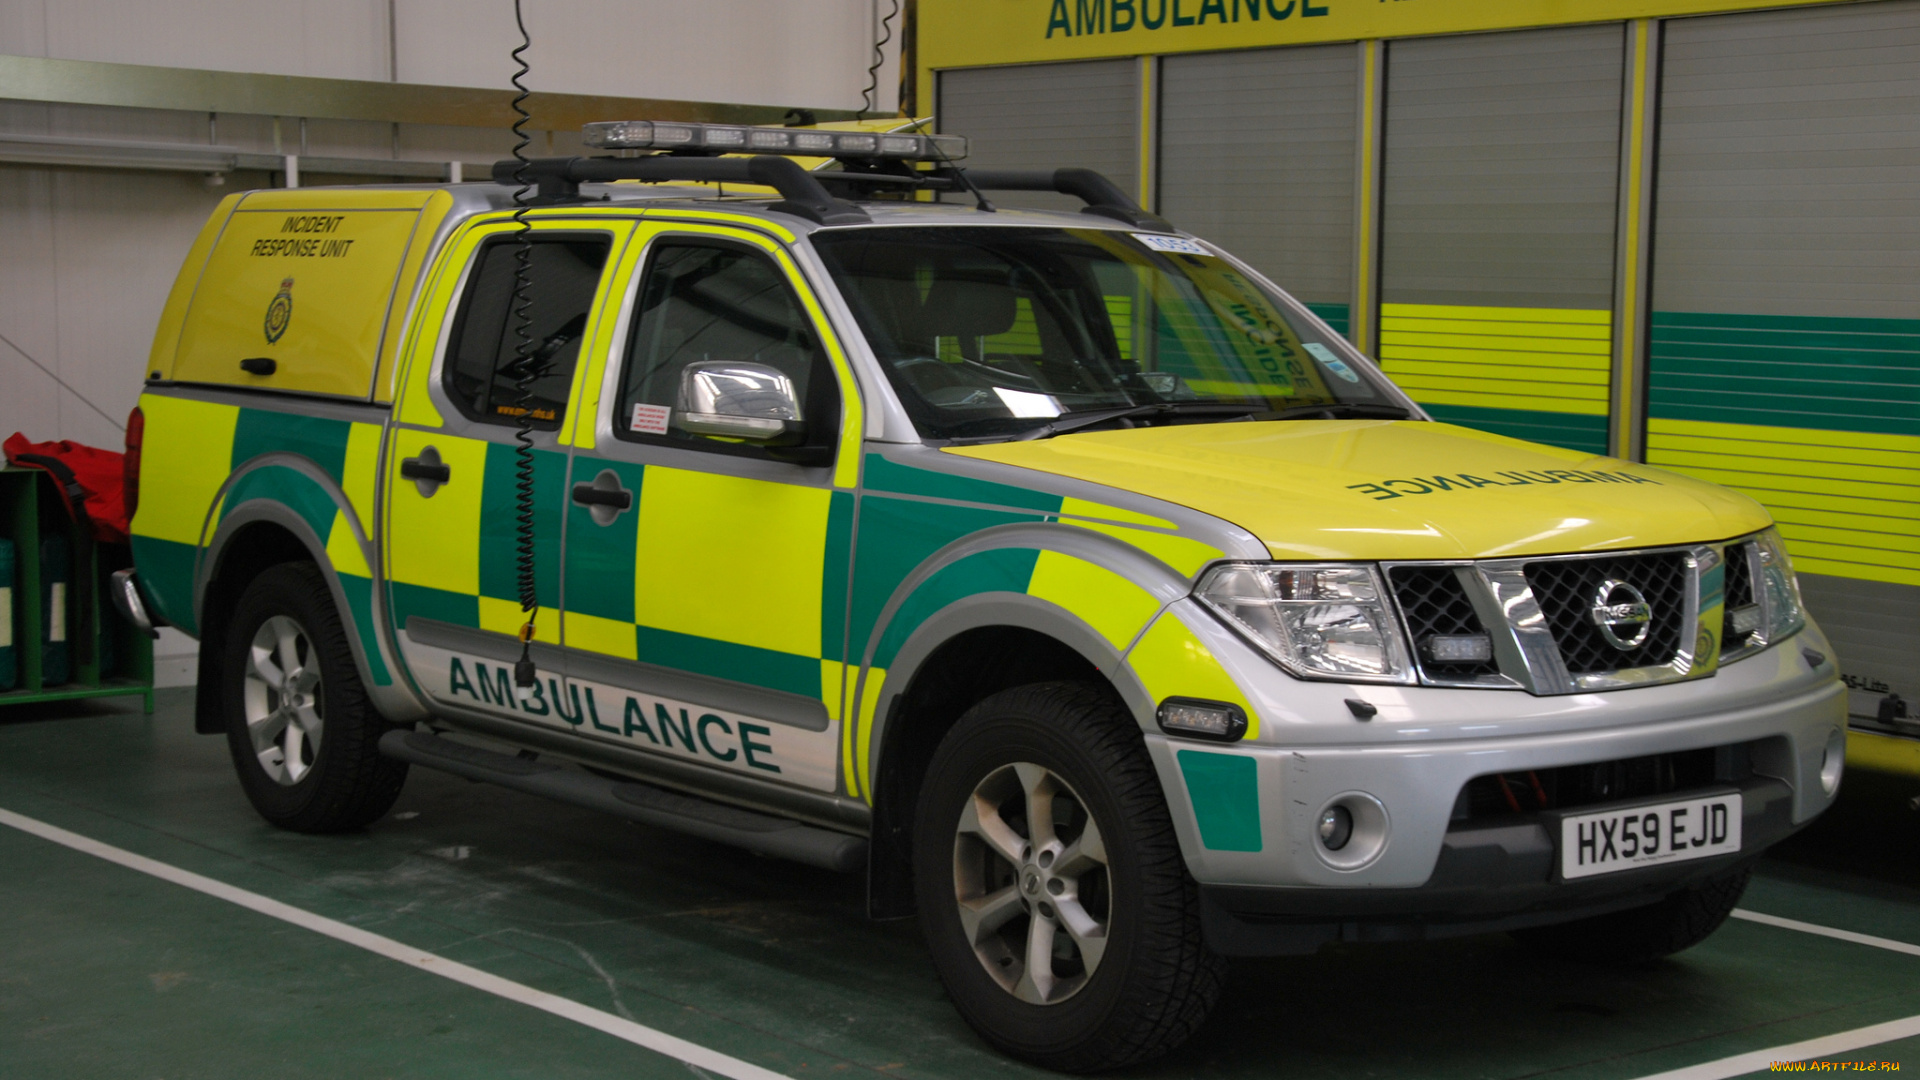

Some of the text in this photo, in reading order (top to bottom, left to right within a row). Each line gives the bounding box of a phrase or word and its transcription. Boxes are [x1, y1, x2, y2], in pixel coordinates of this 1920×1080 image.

[281, 216, 345, 233] INCIDENT
[250, 239, 354, 258] RESPONSE UNIT
[449, 656, 782, 774] AMBULANCE
[1578, 803, 1727, 865] HX59 EJD
